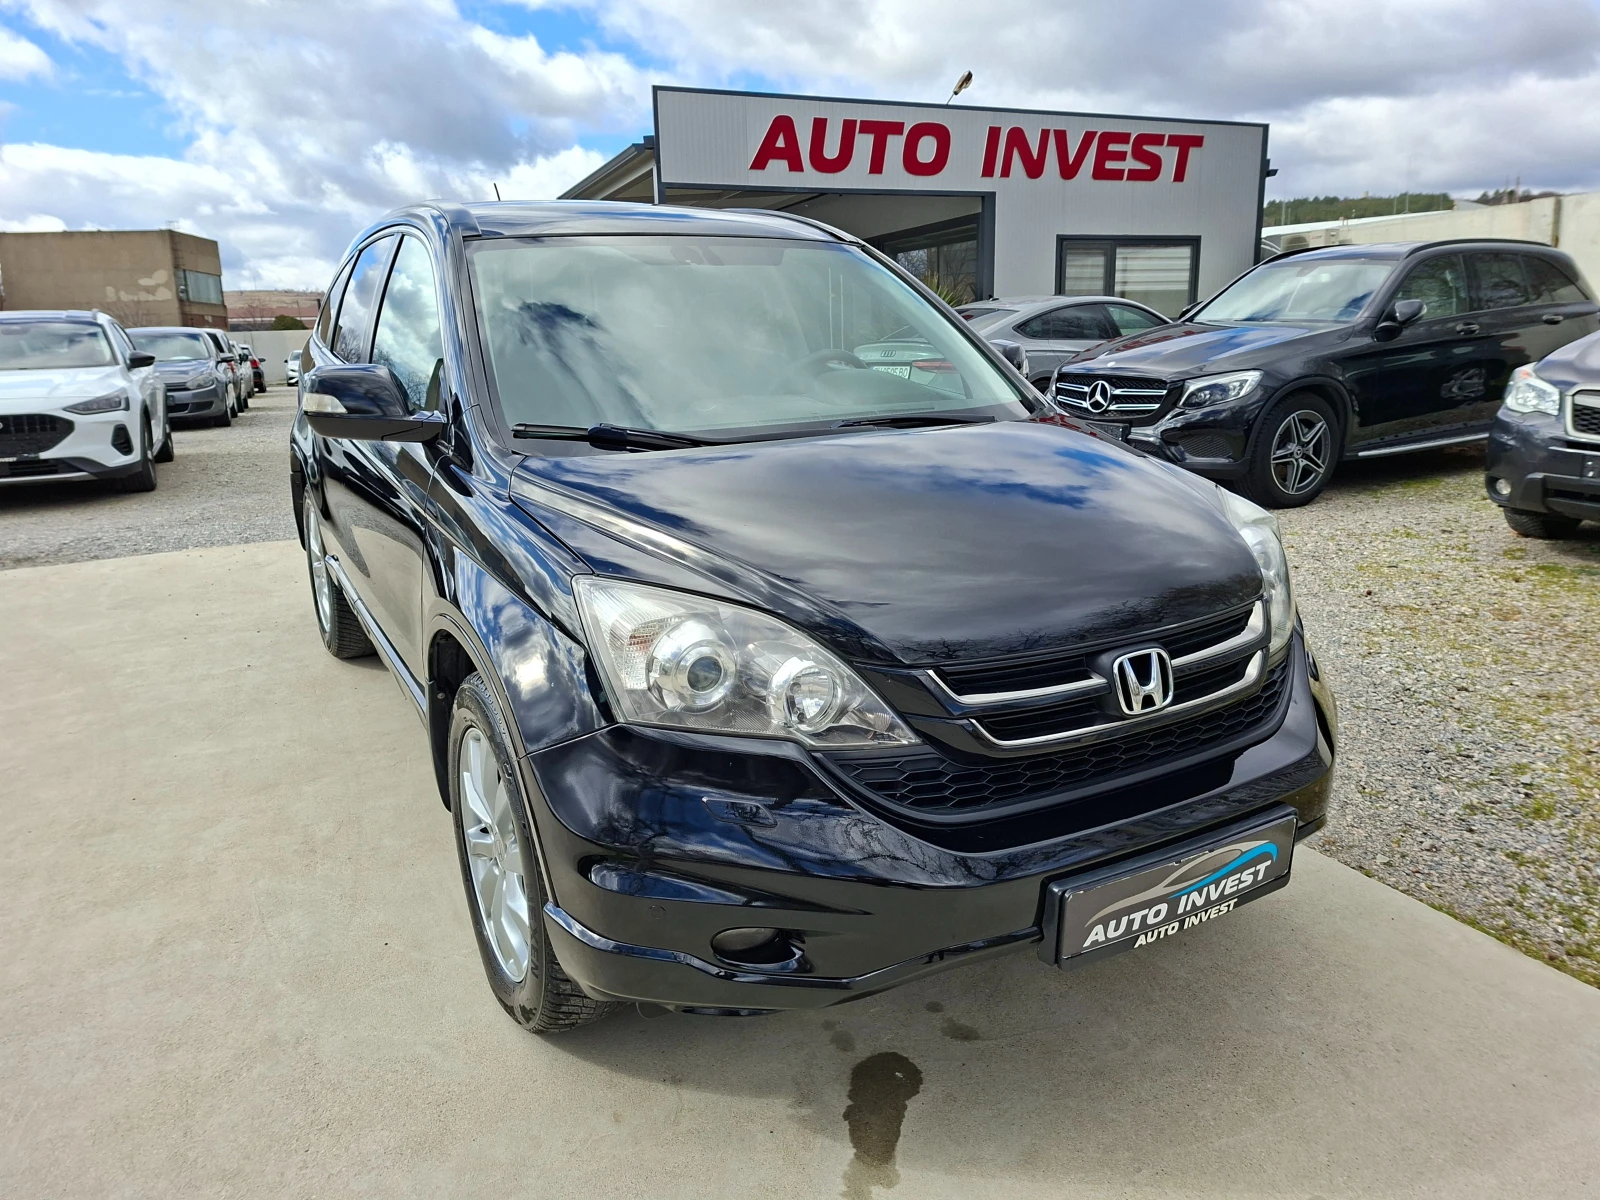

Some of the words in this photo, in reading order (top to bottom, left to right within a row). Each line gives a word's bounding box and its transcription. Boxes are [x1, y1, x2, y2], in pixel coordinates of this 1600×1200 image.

[749, 114, 951, 177] AUTO
[981, 125, 1205, 183] INVEST
[527, 884, 539, 979] NEXEN
[1083, 902, 1168, 947] AUTO
[1177, 860, 1271, 915] INVEST
[1134, 921, 1179, 949] AUTO
[1183, 898, 1238, 930] INVEST
